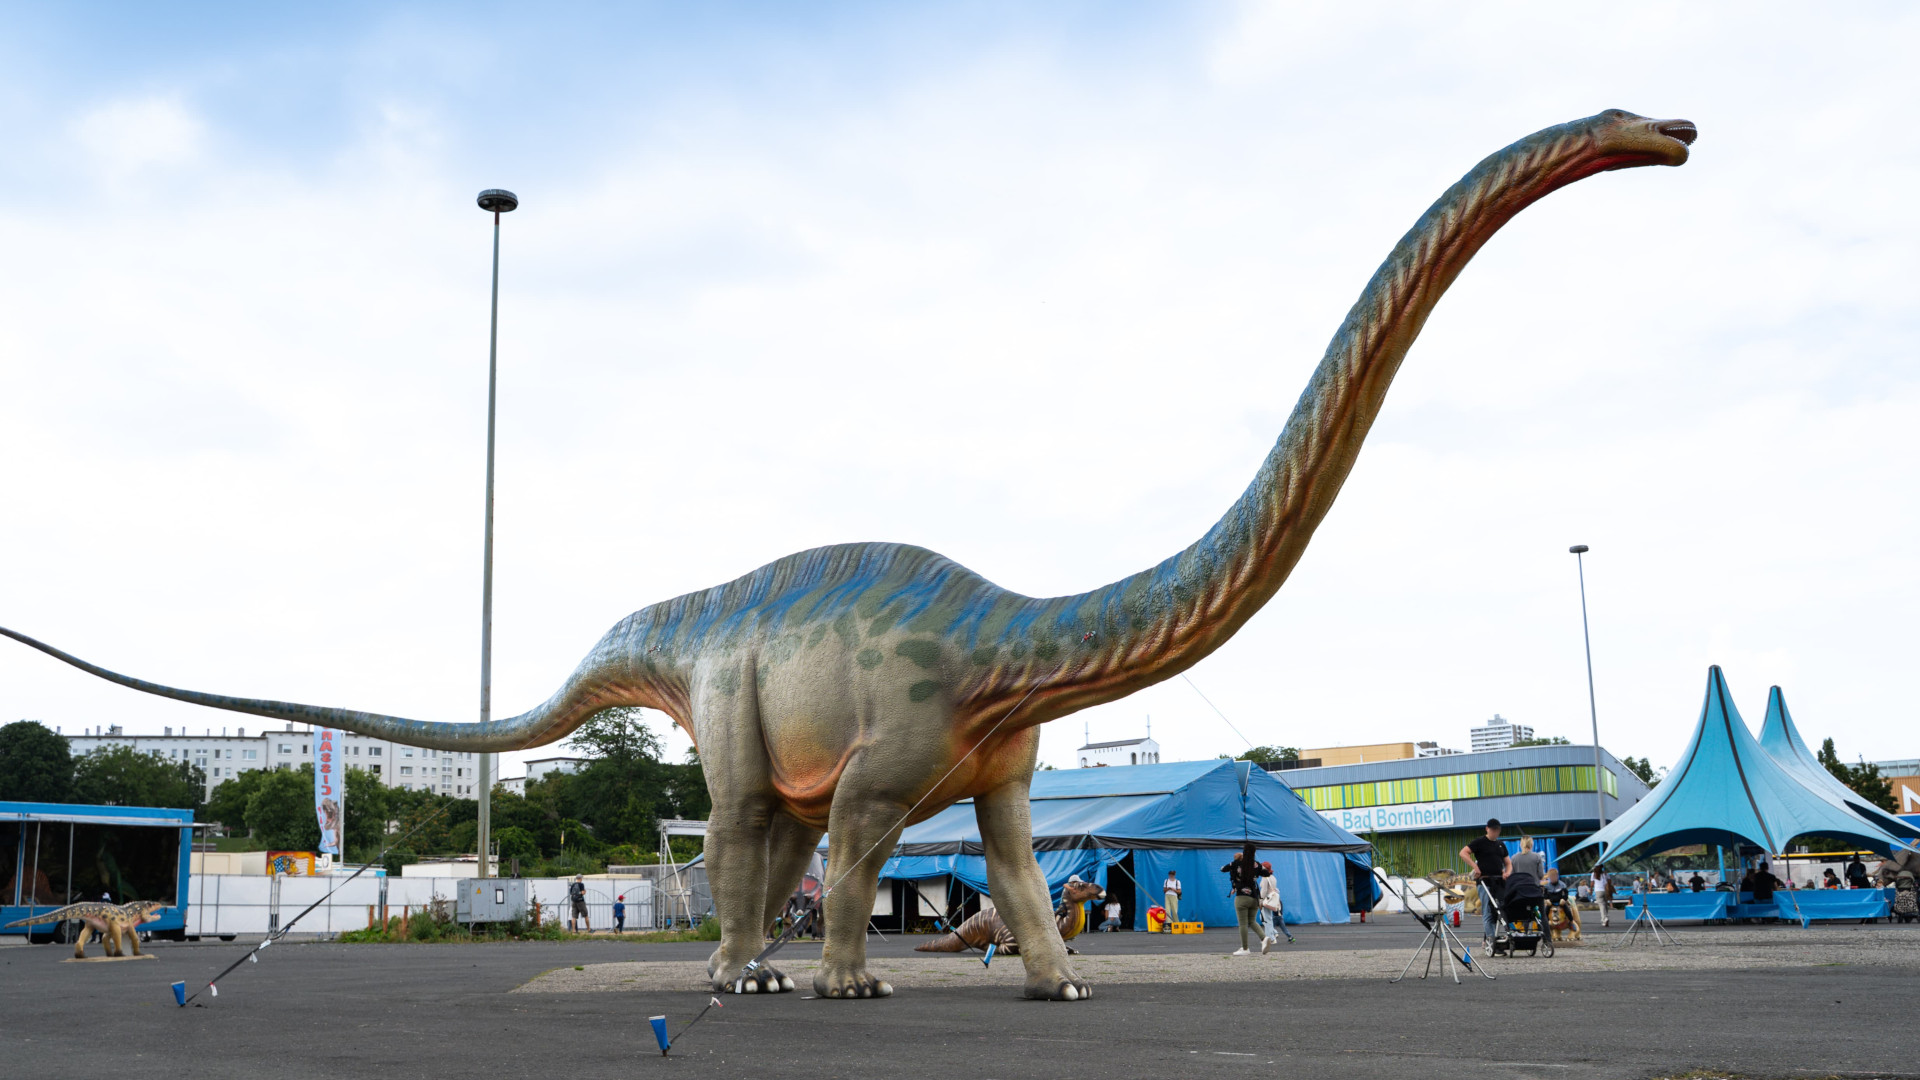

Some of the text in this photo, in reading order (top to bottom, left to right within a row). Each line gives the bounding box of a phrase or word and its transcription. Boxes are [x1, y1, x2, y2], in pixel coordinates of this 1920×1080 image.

[1324, 805, 1452, 830] n Bad Bornheim
